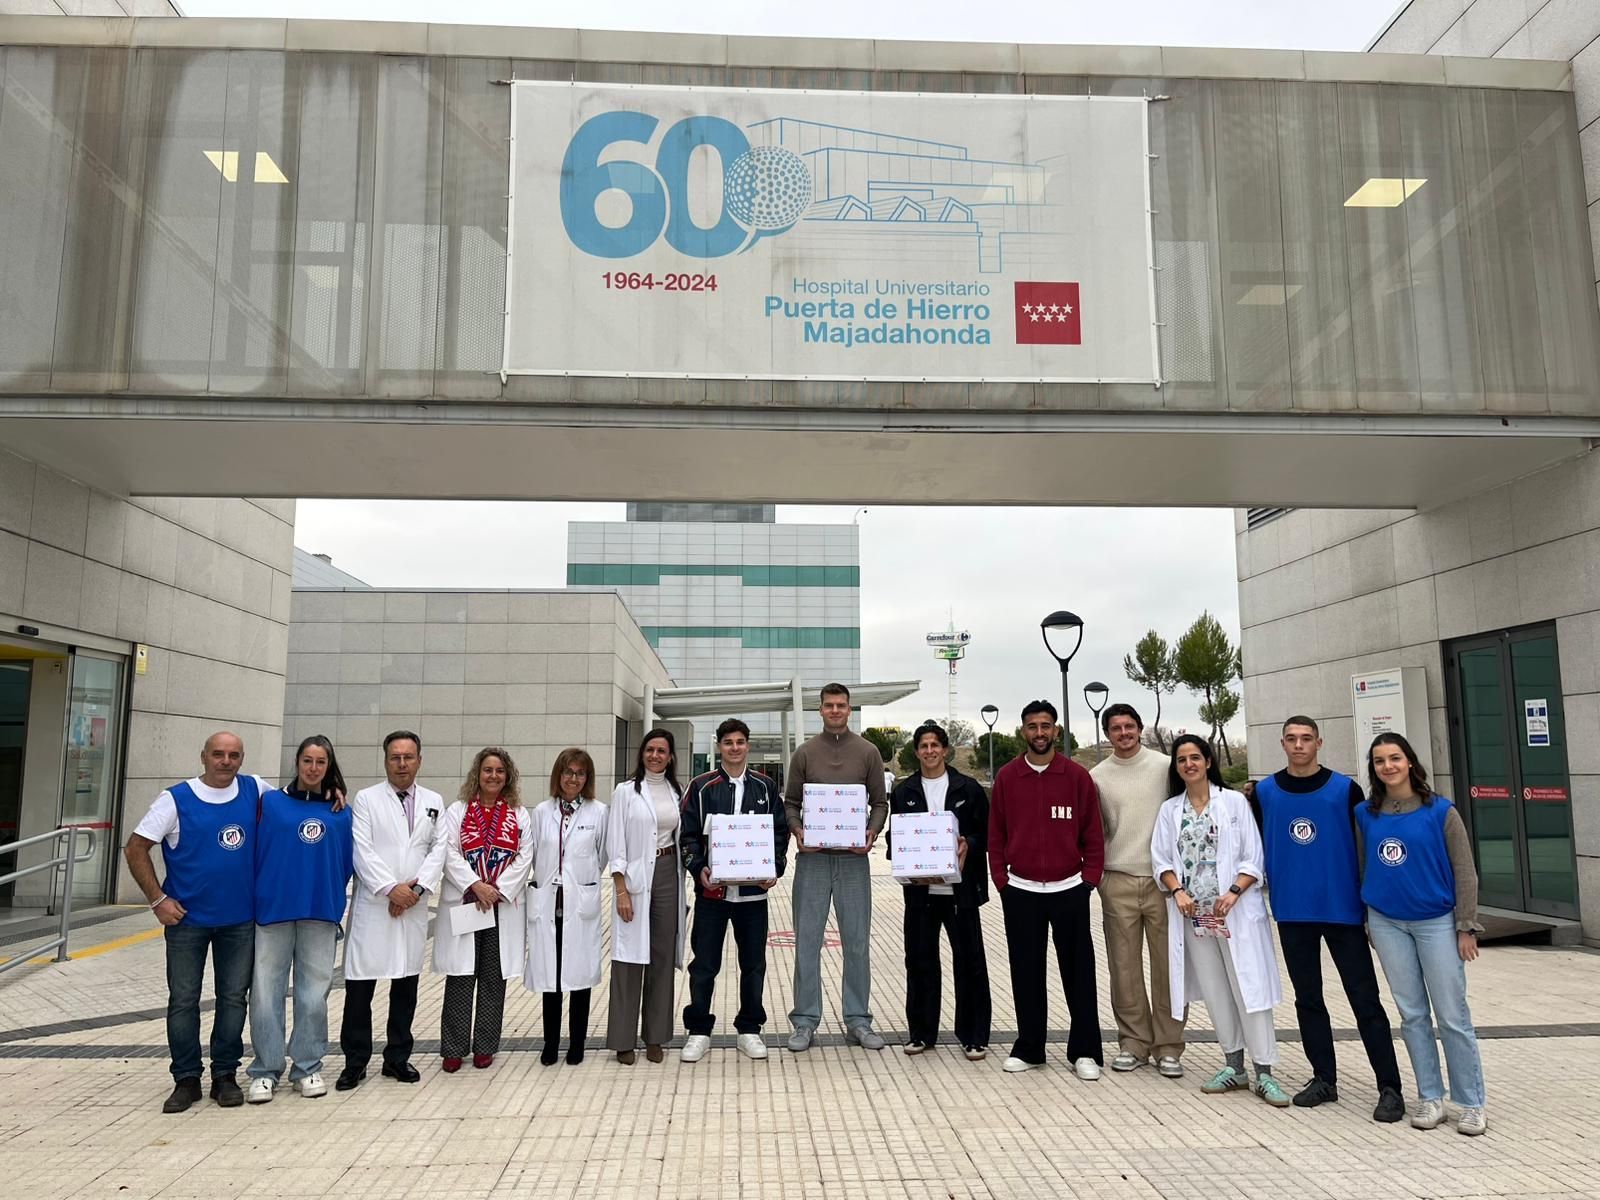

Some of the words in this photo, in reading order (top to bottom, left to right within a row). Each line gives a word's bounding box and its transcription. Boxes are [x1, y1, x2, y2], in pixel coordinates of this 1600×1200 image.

[560, 110, 762, 258] 60
[602, 271, 718, 292] 1964-2024
[793, 278, 868, 296] Hospital
[875, 280, 990, 296] Universitario
[765, 296, 854, 318] Puerta
[864, 298, 897, 319] de
[907, 298, 990, 320] Hierro
[804, 321, 990, 347] Majadahonda
